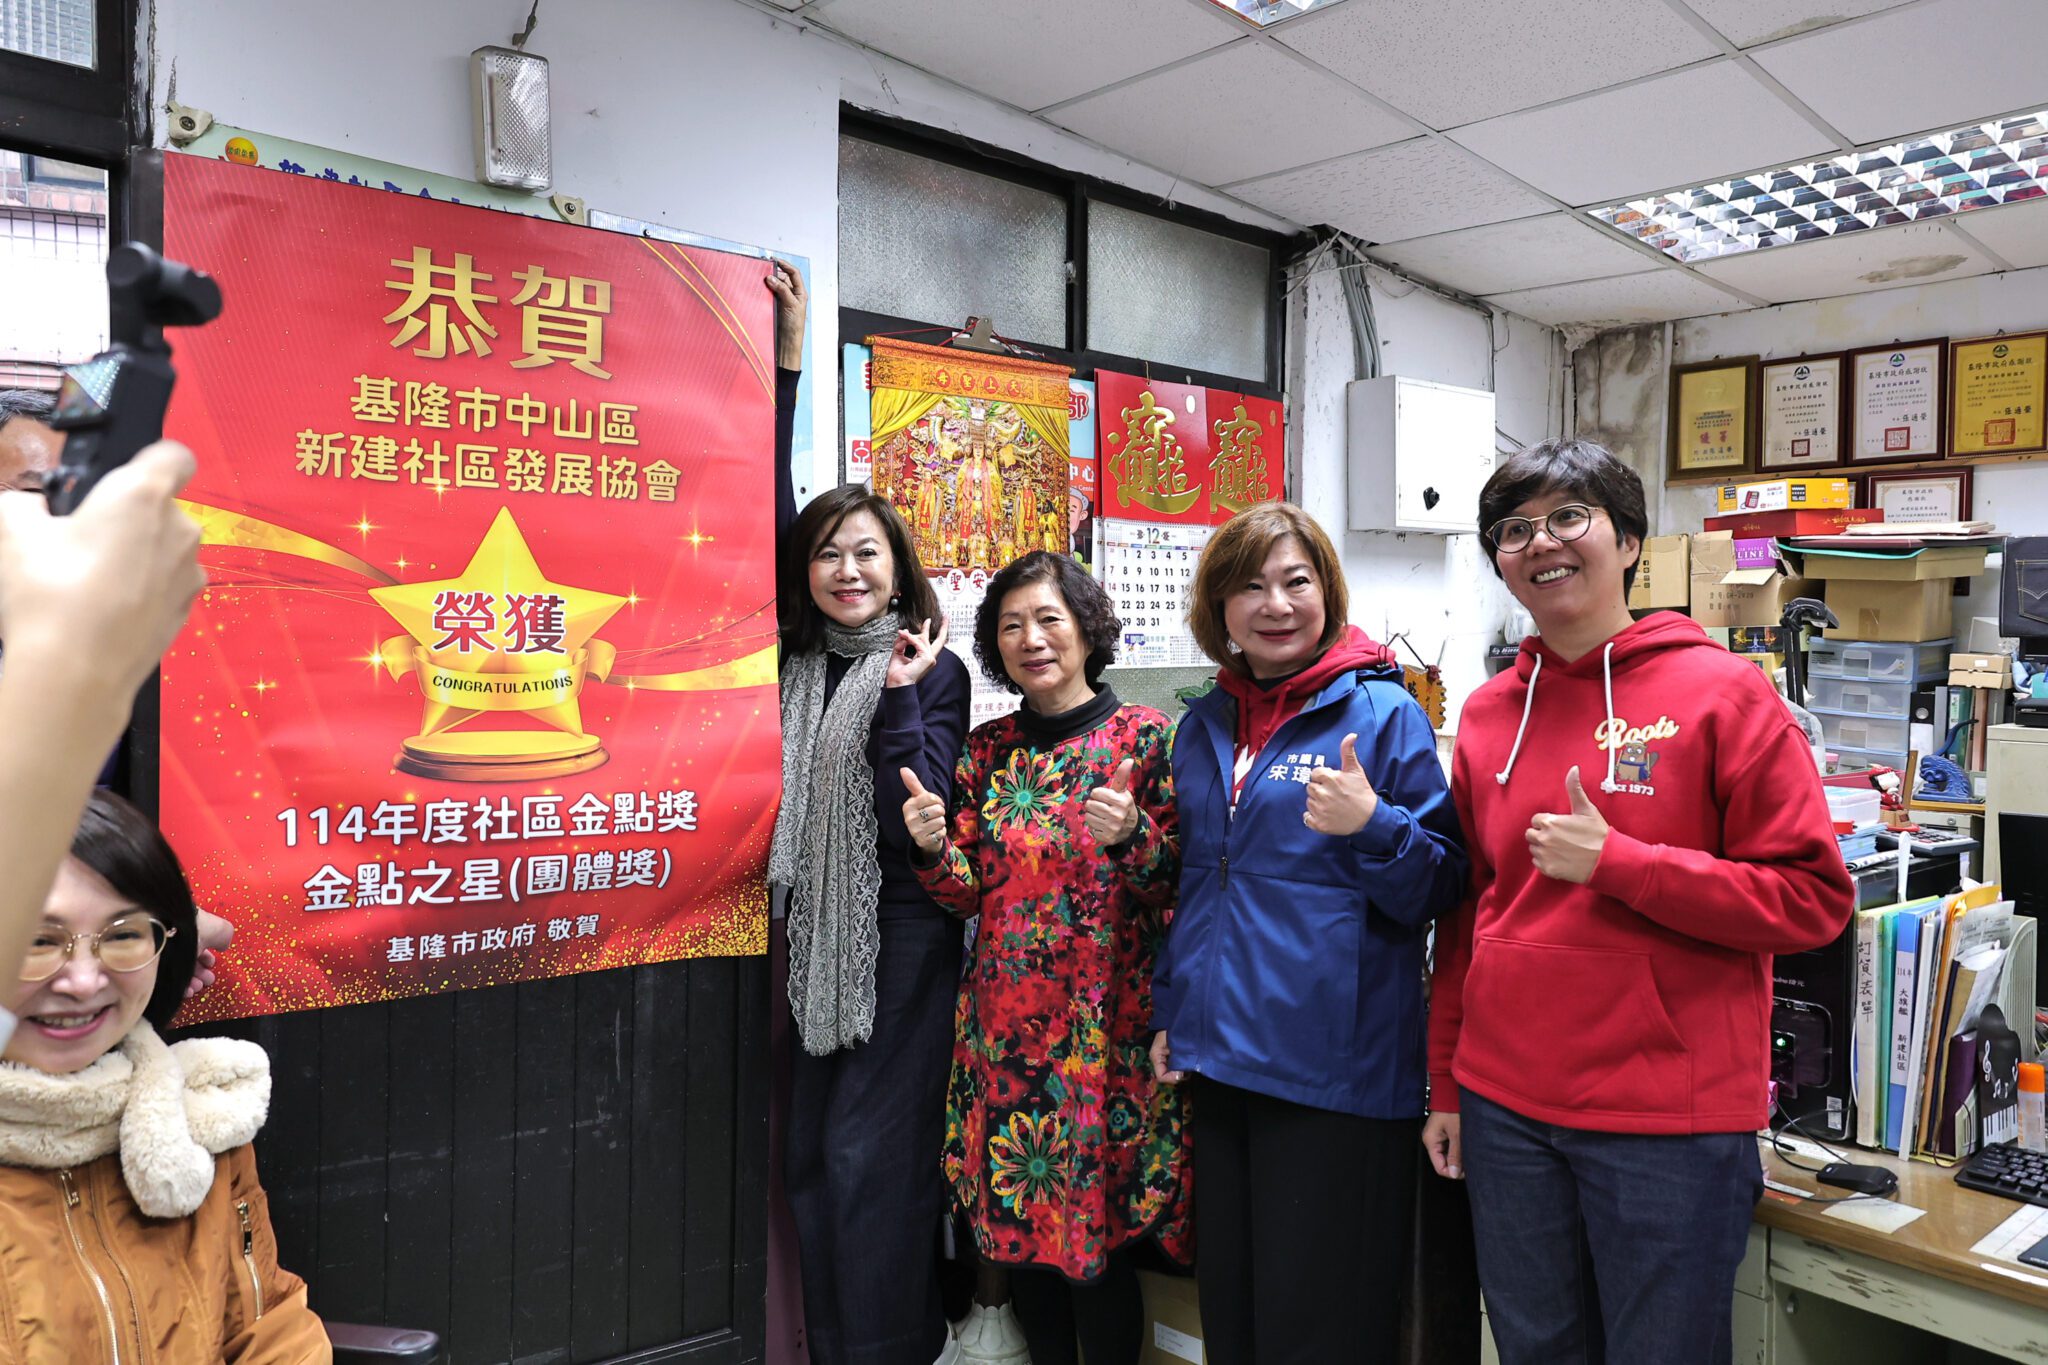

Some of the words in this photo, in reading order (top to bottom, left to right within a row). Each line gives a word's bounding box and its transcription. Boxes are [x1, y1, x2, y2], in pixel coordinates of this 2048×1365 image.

[382, 246, 613, 380] 恭賀
[350, 374, 640, 446] 基隆市中山區
[295, 428, 682, 502] 新建社區發展協會
[1146, 527, 1160, 544] 12
[1136, 550, 1141, 558] 2
[1151, 551, 1156, 559] 3
[1166, 551, 1171, 559] 4
[1182, 552, 1187, 560] 5
[1110, 566, 1114, 574] 7
[1123, 566, 1128, 575] 8
[1137, 567, 1142, 575] 9
[1150, 567, 1159, 576] 10
[1165, 568, 1173, 576] 11
[1181, 568, 1190, 577] 12
[1108, 583, 1116, 591] 14
[1122, 583, 1130, 592] 15
[1136, 584, 1144, 592] 16
[1150, 584, 1159, 593] 17
[1165, 585, 1175, 593] 18
[1122, 601, 1131, 609] 22
[1136, 601, 1145, 609] 23
[1150, 601, 1160, 610] 24
[1166, 601, 1175, 610] 25
[432, 591, 567, 654] 榮獲
[1122, 618, 1131, 626] 29
[1136, 618, 1146, 626] 30
[1150, 618, 1160, 626] 31
[432, 675, 574, 694] CONGRATULATIONS
[1594, 715, 1680, 751] Roots
[1267, 764, 1312, 785] 宋瑋
[1629, 784, 1654, 796] 1973
[276, 790, 699, 847] 114年度社區金點獎
[302, 848, 672, 912] 金點之星(團體獎)
[386, 924, 537, 963] 基隆市政府
[547, 914, 600, 942] 敬賀
